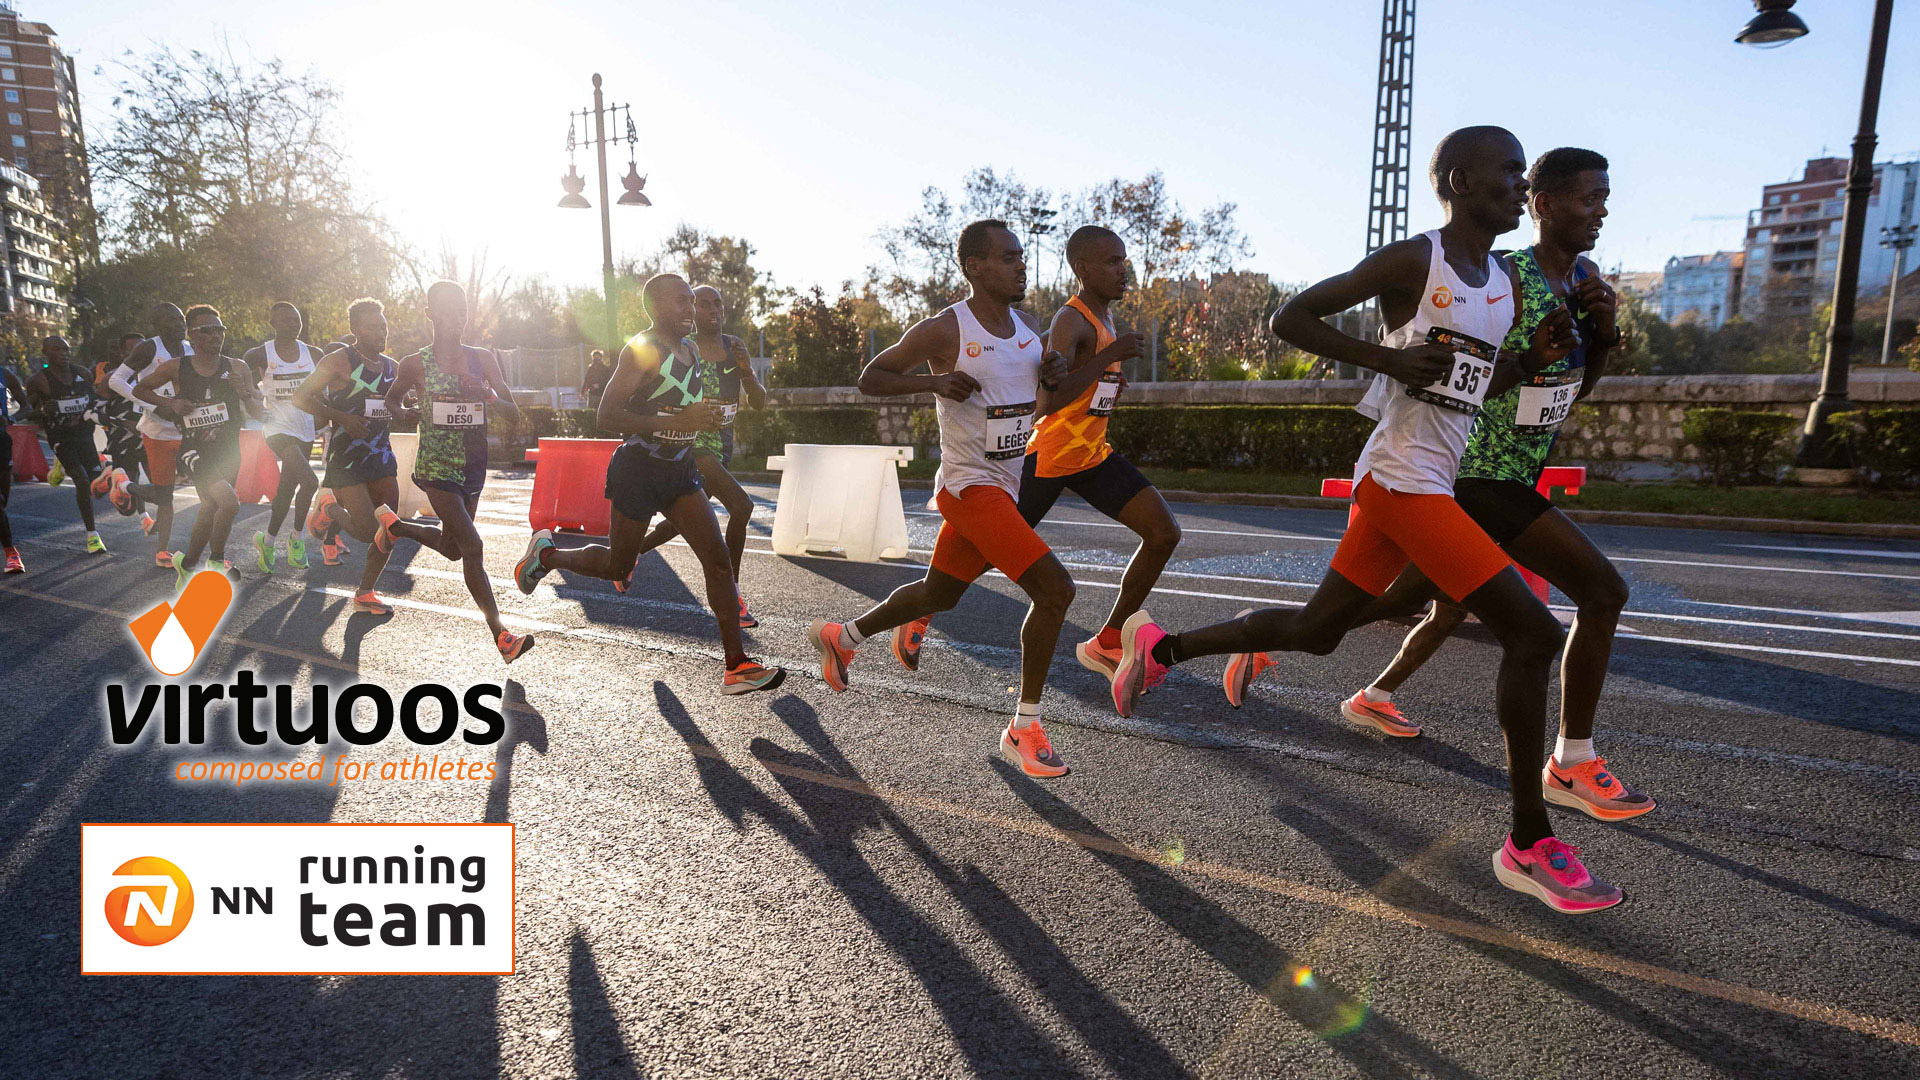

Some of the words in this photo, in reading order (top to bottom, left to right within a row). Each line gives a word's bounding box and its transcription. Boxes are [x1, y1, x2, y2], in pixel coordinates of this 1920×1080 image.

[1553, 388, 1569, 403] 136
[200, 408, 210, 416] 31
[456, 404, 467, 413] 20
[1538, 403, 1569, 423] PACE
[189, 413, 224, 427] KIBROM
[447, 414, 473, 424] DESO
[1016, 419, 1022, 431] 2
[997, 431, 1030, 450] LEGES
